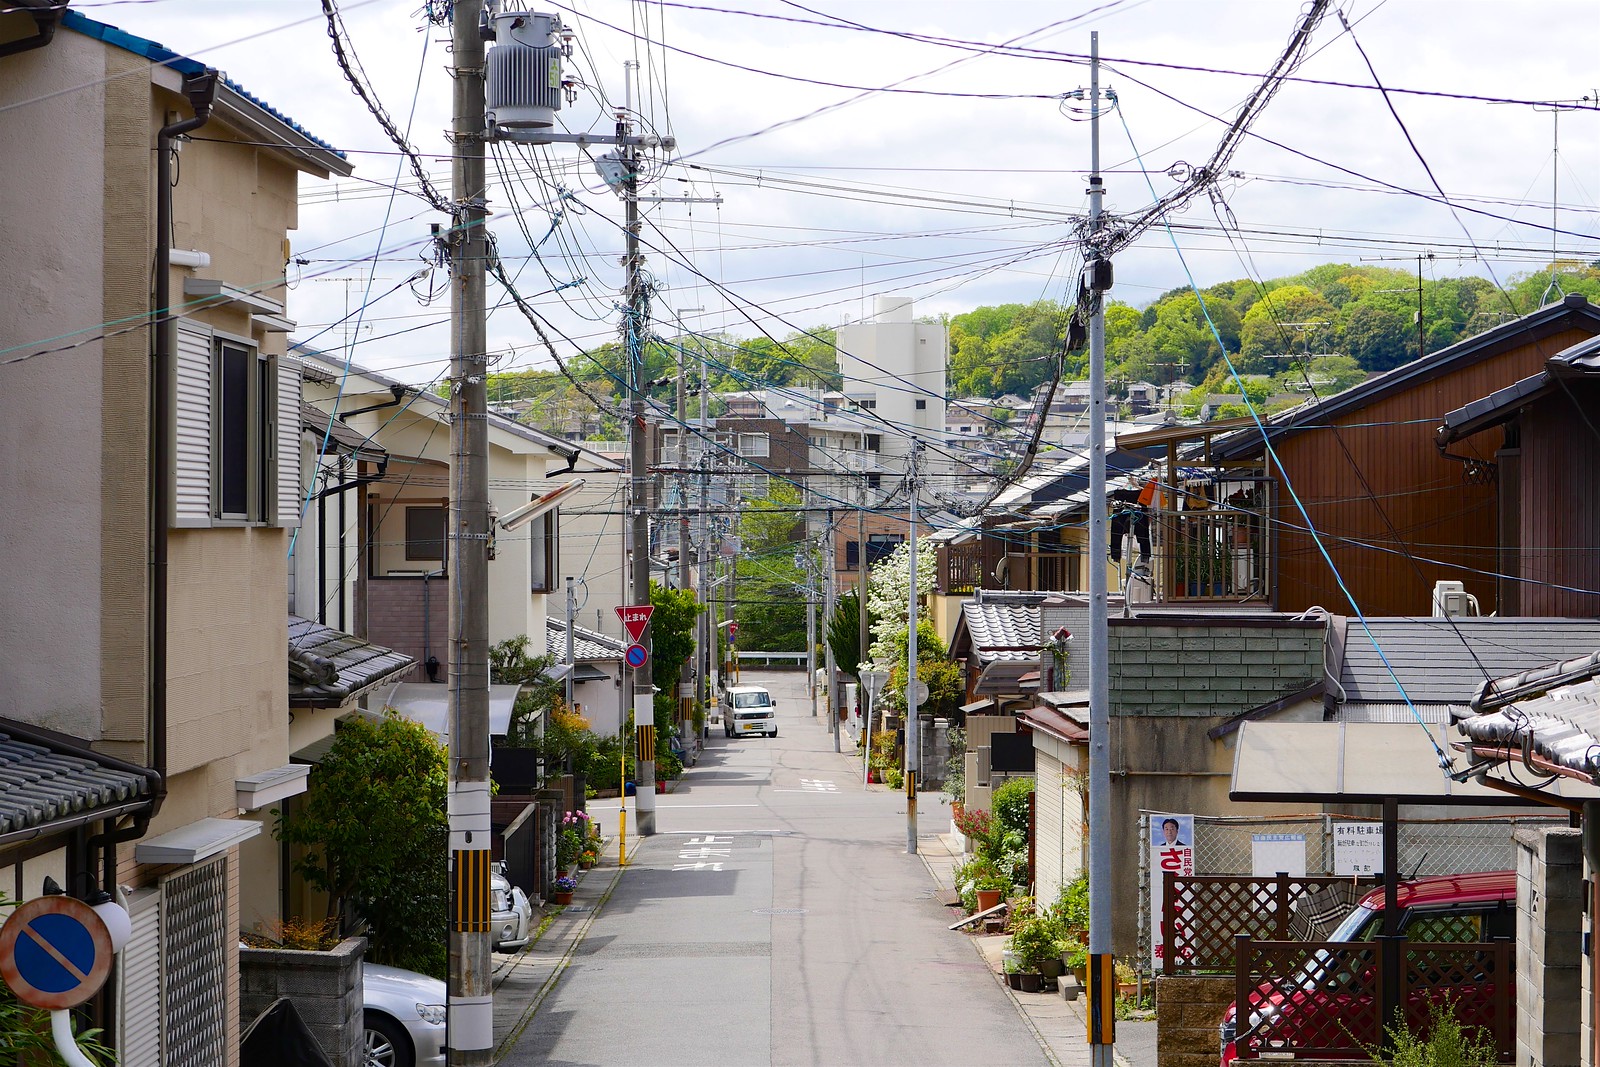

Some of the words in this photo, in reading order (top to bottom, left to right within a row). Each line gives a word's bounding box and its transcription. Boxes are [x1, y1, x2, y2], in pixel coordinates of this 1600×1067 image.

[624, 613, 647, 622] 止まれ
[1183, 848, 1192, 876] 自民党
